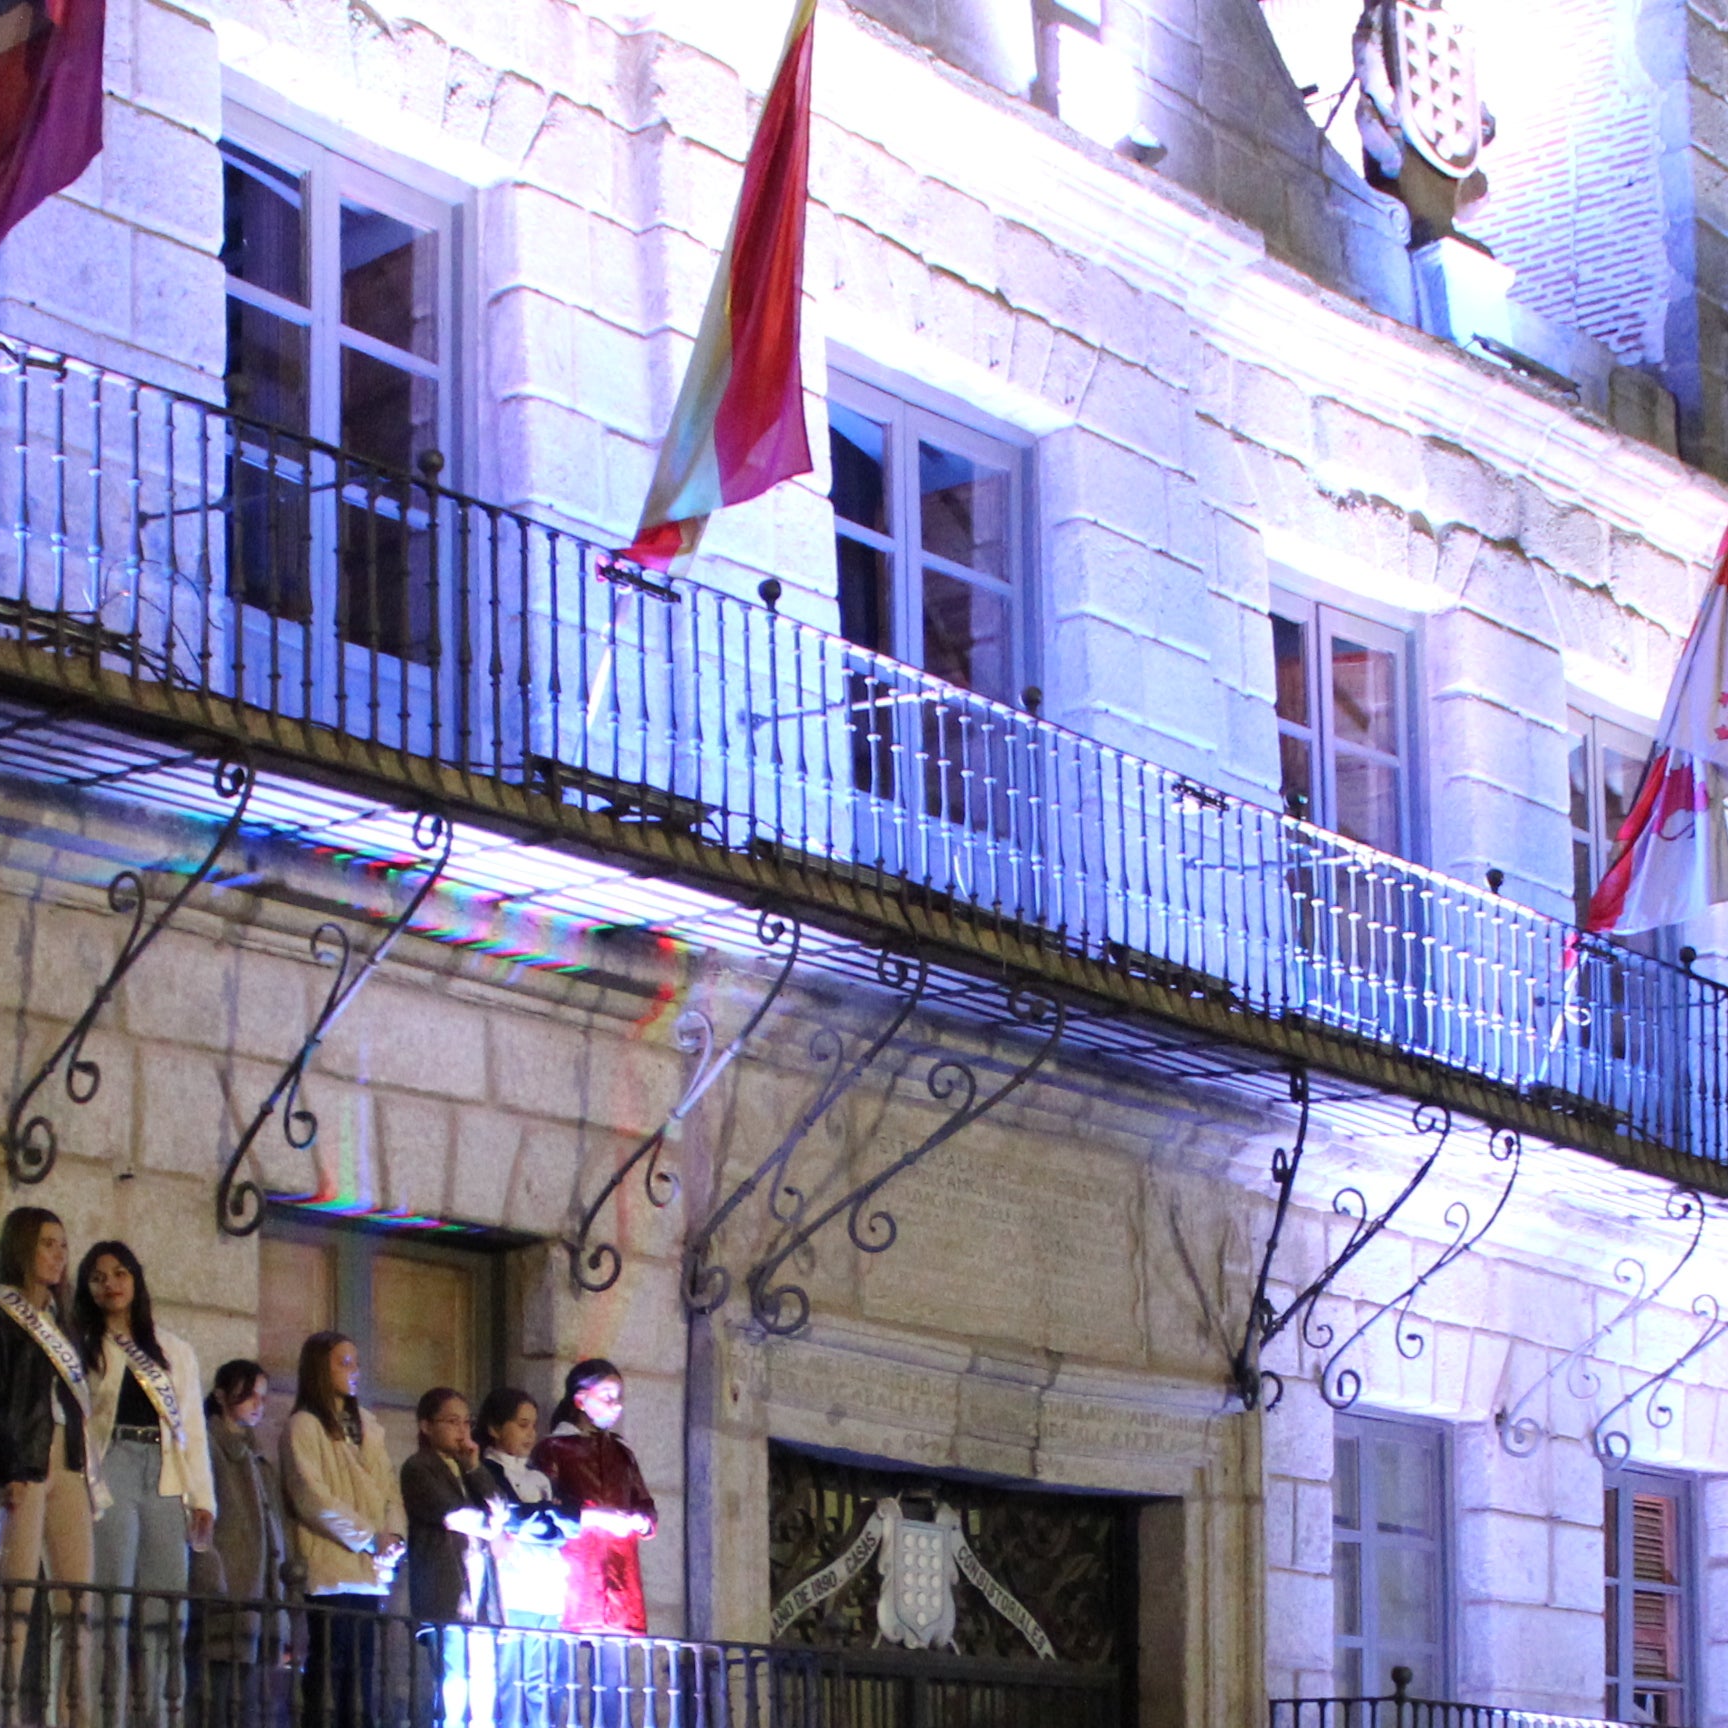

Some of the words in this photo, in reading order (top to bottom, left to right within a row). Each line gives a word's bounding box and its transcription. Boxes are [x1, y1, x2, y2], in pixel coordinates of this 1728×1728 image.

[3, 1292, 52, 1340] Dama
[793, 1585, 812, 1609] DE
[845, 1530, 877, 1574] CASAS
[958, 1545, 1046, 1651] CONSISTORIALES
